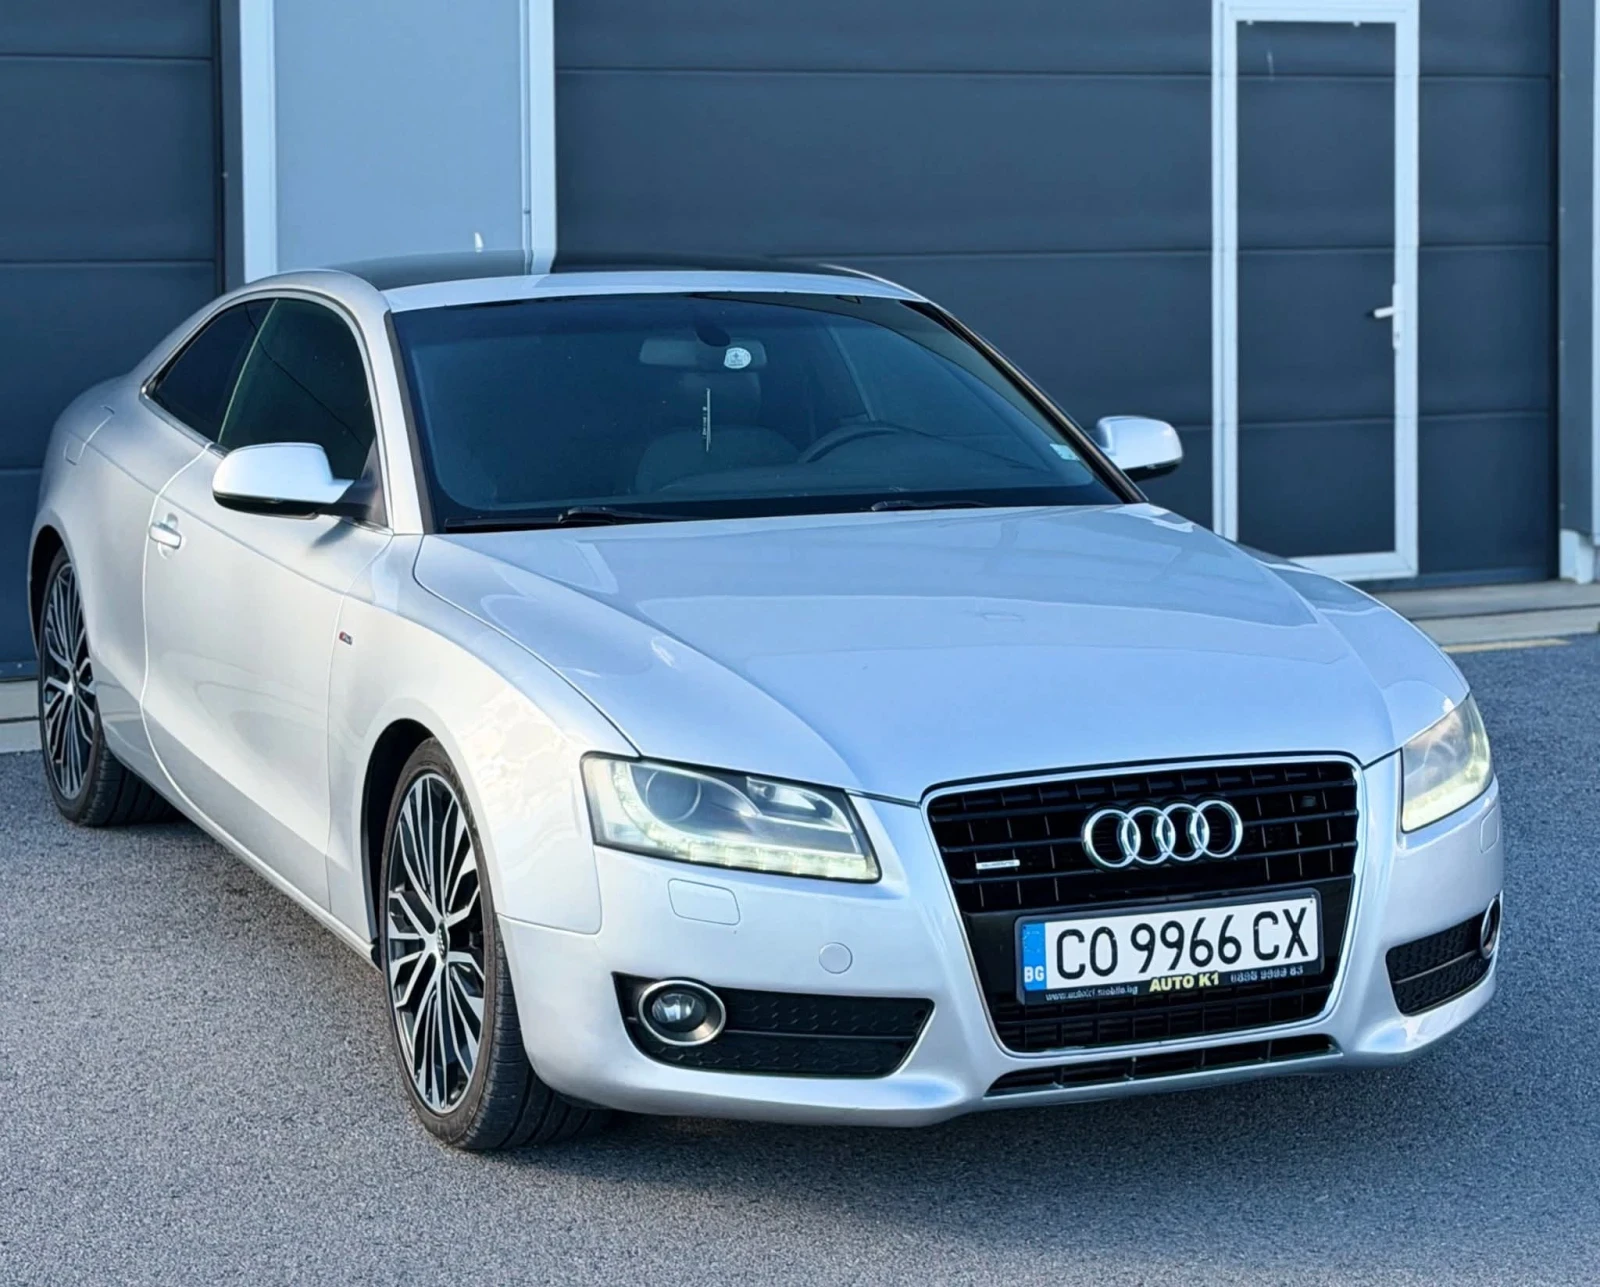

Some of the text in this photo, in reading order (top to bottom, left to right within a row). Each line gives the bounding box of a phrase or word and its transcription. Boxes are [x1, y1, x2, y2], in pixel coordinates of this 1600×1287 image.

[1130, 914, 1242, 974] 9966
[1252, 907, 1309, 961] CX
[1024, 965, 1045, 983] BG
[1149, 972, 1220, 992] AUTO K1
